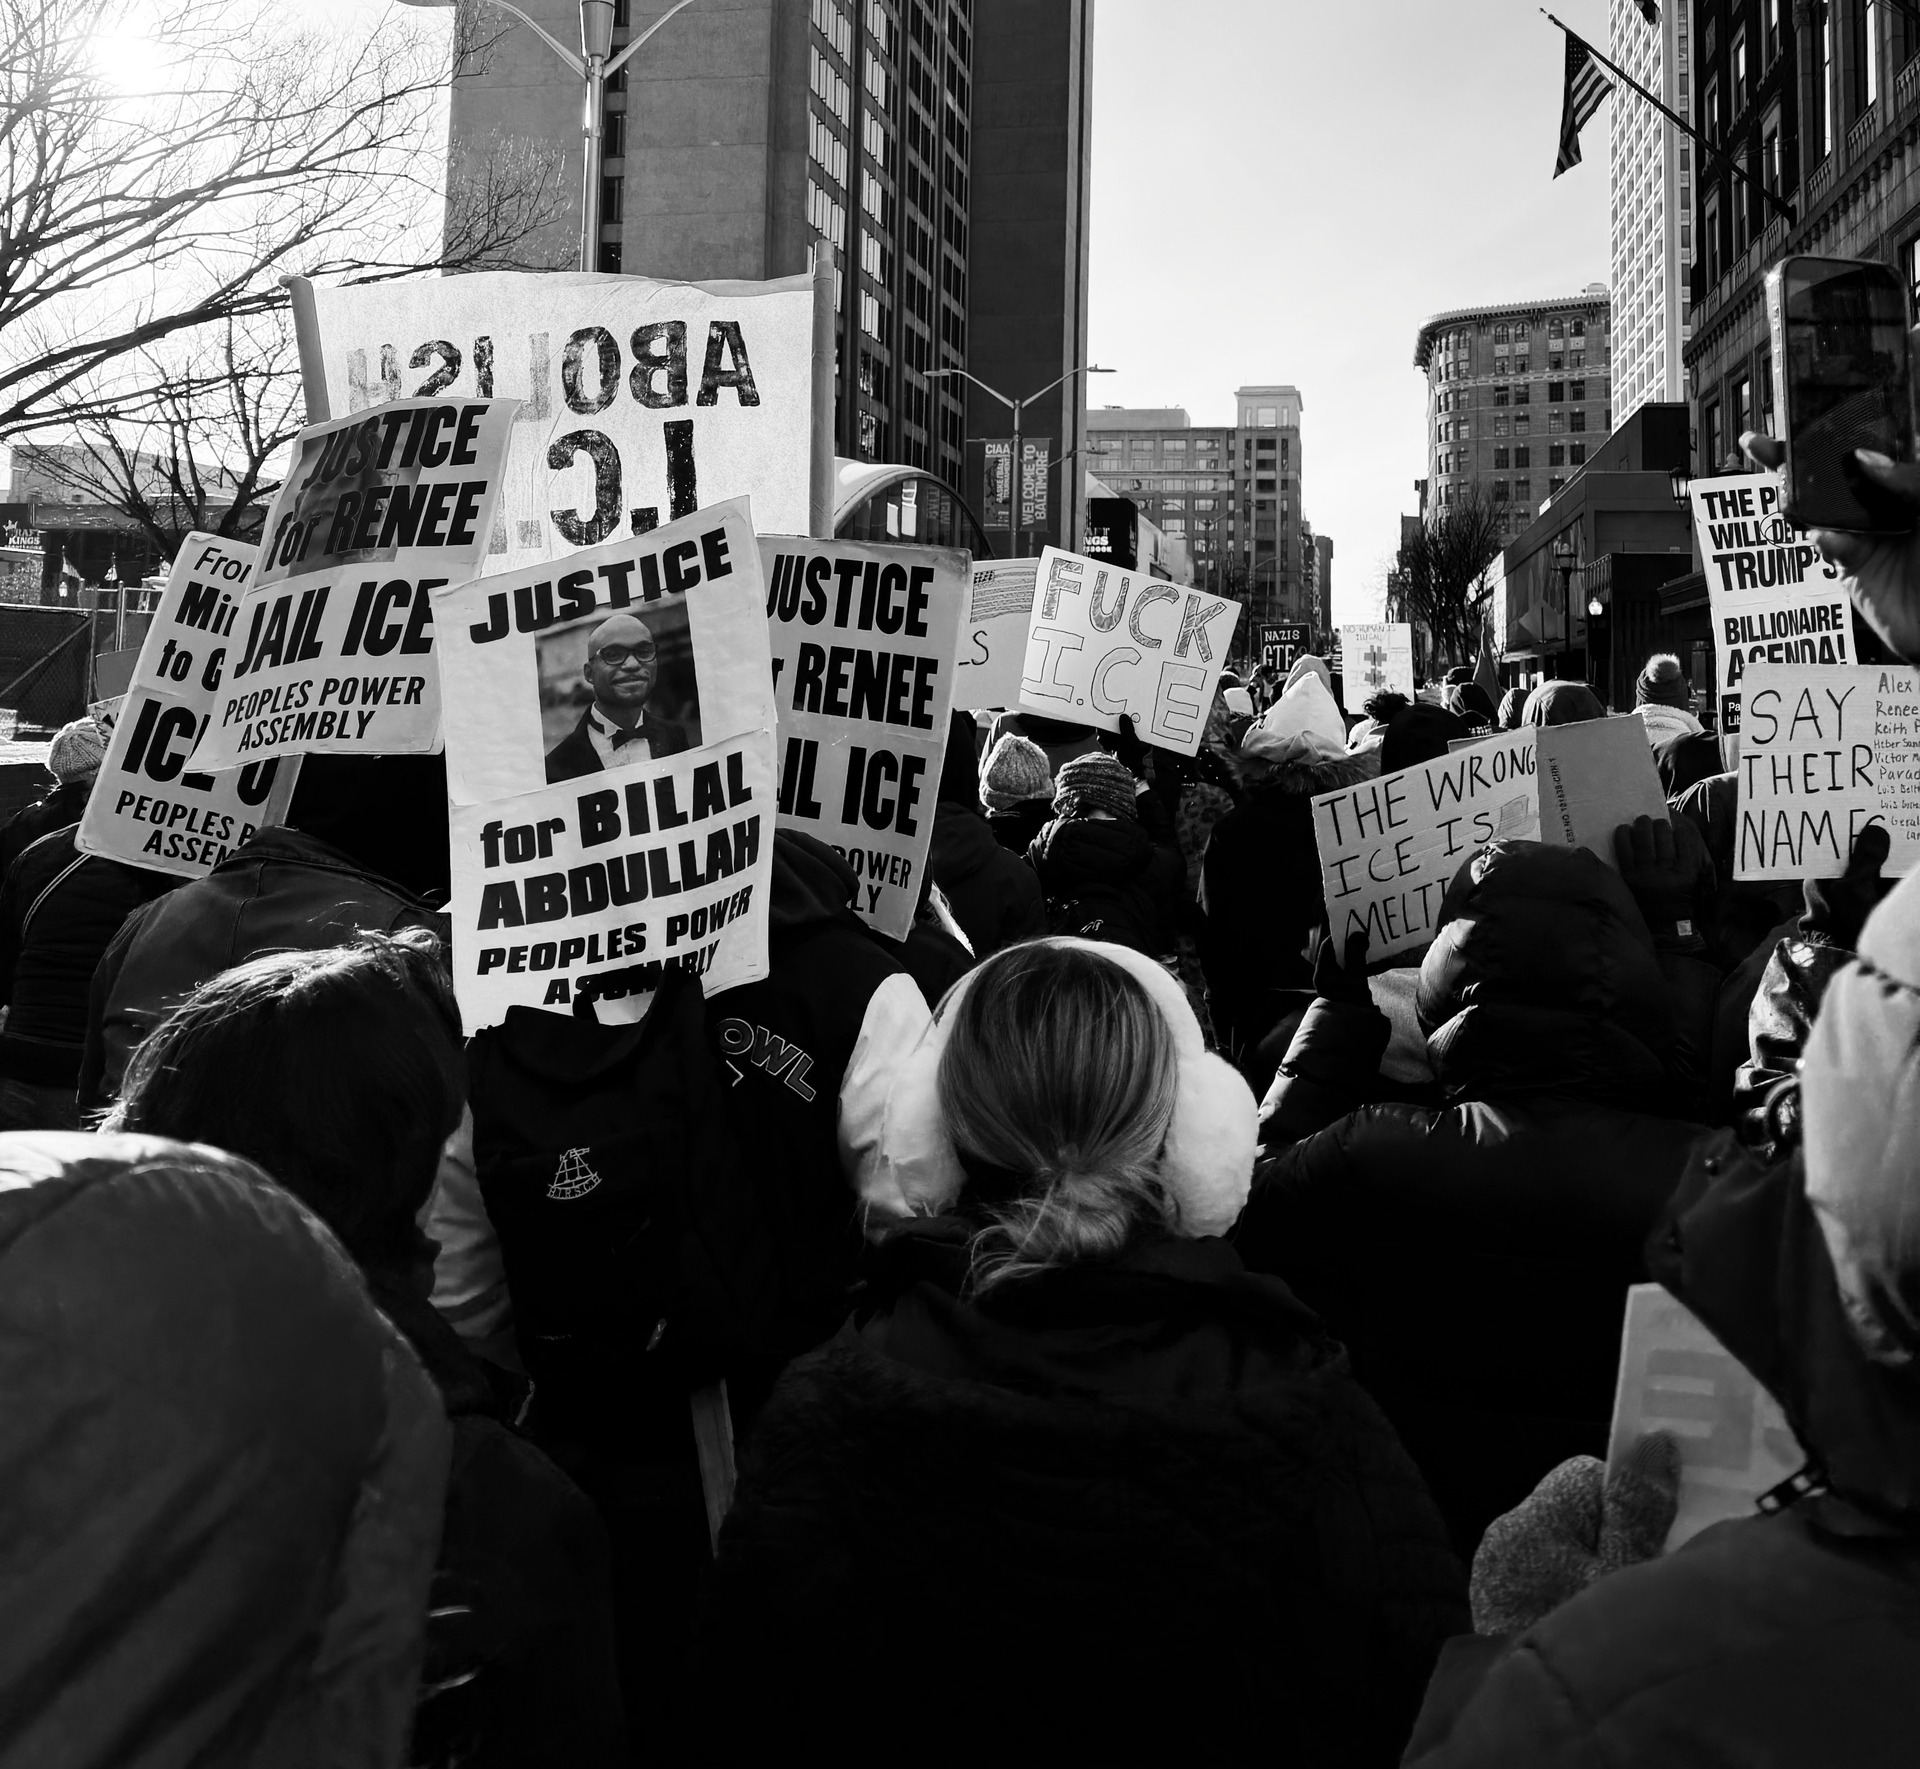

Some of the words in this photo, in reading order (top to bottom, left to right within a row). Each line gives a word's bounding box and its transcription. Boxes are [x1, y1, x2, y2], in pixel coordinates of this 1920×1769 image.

[300, 404, 490, 490] JUSTICE
[985, 443, 1010, 455] CIAA
[1024, 444, 1036, 461] TO
[996, 458, 1004, 503] BASKETBALL
[1022, 463, 1036, 525] WELCOME
[1035, 450, 1048, 520] BALTIMORE
[1700, 488, 1755, 521] THE
[1759, 486, 1779, 515] P
[9, 536, 40, 545] KINGS
[264, 512, 321, 572] for
[323, 480, 488, 555] RENEE
[1083, 535, 1109, 546] NGS
[1708, 520, 1767, 550] WILL
[469, 527, 733, 644] JUSTICE
[766, 553, 935, 639] JUSTICE
[1042, 557, 1227, 662] FUCK
[233, 585, 331, 680] JAIL
[340, 578, 449, 657] ICE
[1264, 629, 1300, 642] NAZIS
[1724, 603, 1844, 645] BILLIONAIRE
[156, 638, 193, 682] to
[792, 642, 939, 731] RENEE
[1878, 672, 1912, 694] Alex
[222, 679, 314, 728] PEOPLES
[318, 676, 425, 706] POWER
[1751, 685, 1856, 744] SAY
[1874, 721, 1907, 735] Keith
[1876, 700, 1919, 717] Renee
[237, 710, 376, 753] ASSEMBLY
[778, 736, 822, 820] IL
[841, 745, 926, 838] ICE
[1319, 775, 1408, 846] THE
[1425, 744, 1536, 811] WRONG
[1742, 744, 1874, 799] THEIR
[115, 790, 234, 840] PEOPLES
[480, 817, 567, 869] for
[576, 751, 753, 849] BILAL
[476, 814, 761, 931] ABDULLAH
[1329, 836, 1421, 899] ICE
[1436, 812, 1495, 858] IS
[477, 922, 647, 975] PEOPLES
[666, 884, 753, 947] POWER
